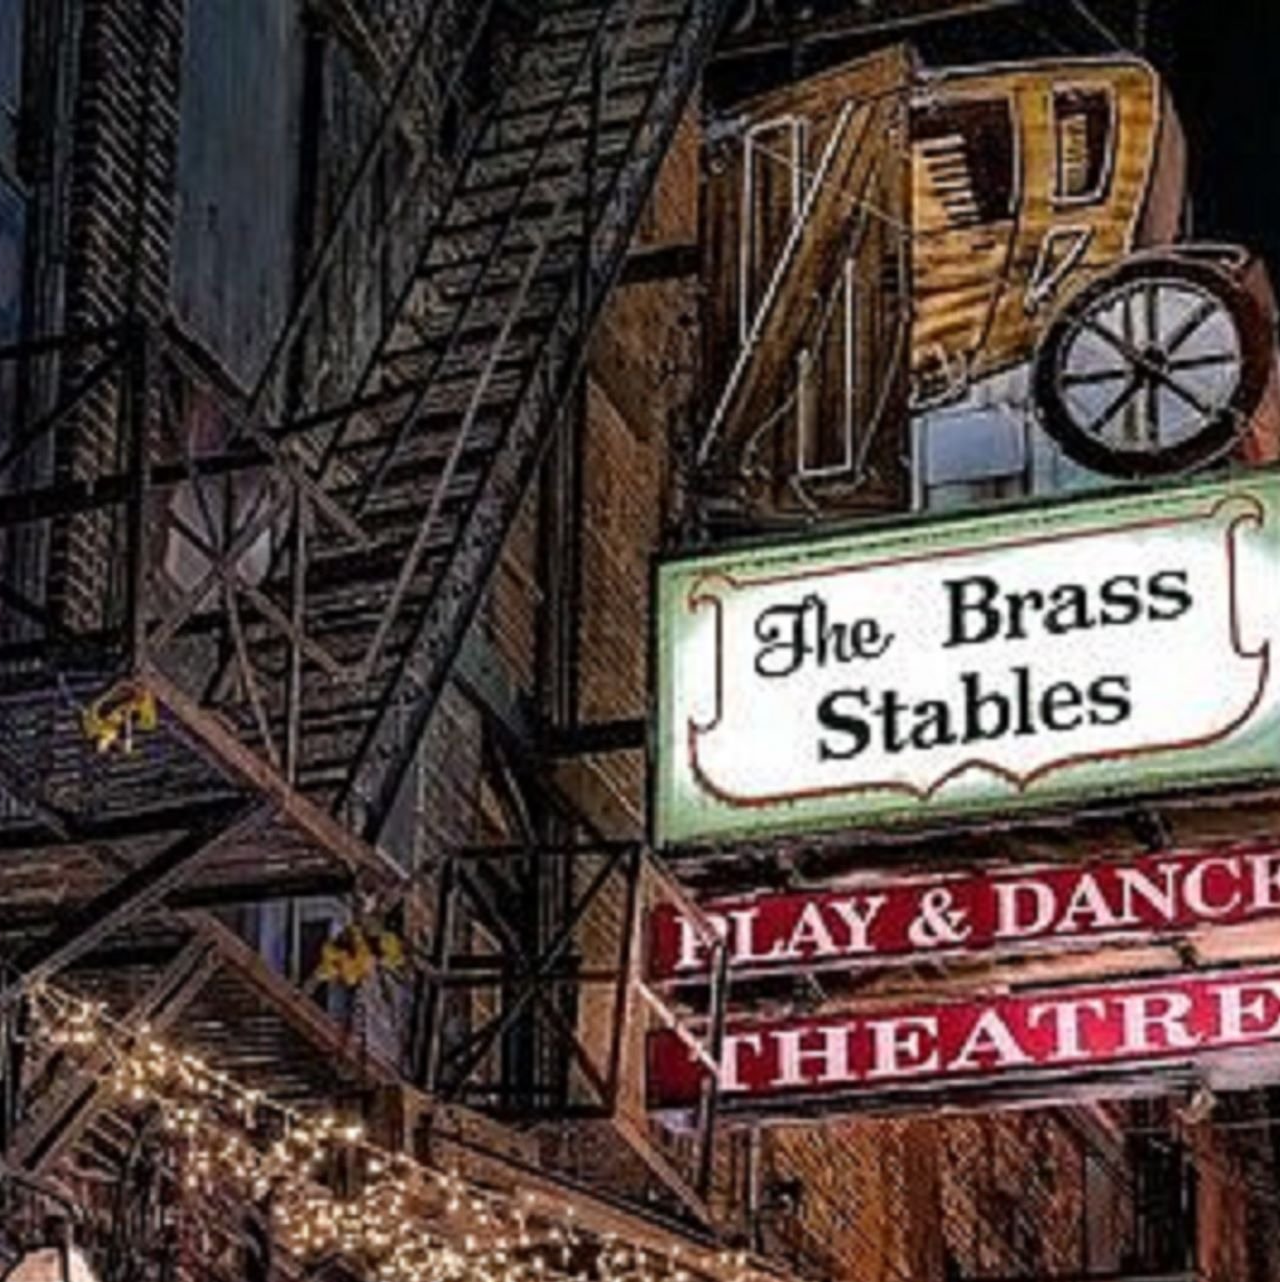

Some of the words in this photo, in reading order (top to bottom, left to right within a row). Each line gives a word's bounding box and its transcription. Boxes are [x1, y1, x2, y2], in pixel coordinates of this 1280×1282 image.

[753, 592, 896, 679] The
[941, 567, 1195, 650] Brass
[816, 668, 1133, 764] Stables
[673, 895, 888, 971] PLAY
[908, 887, 972, 946] &
